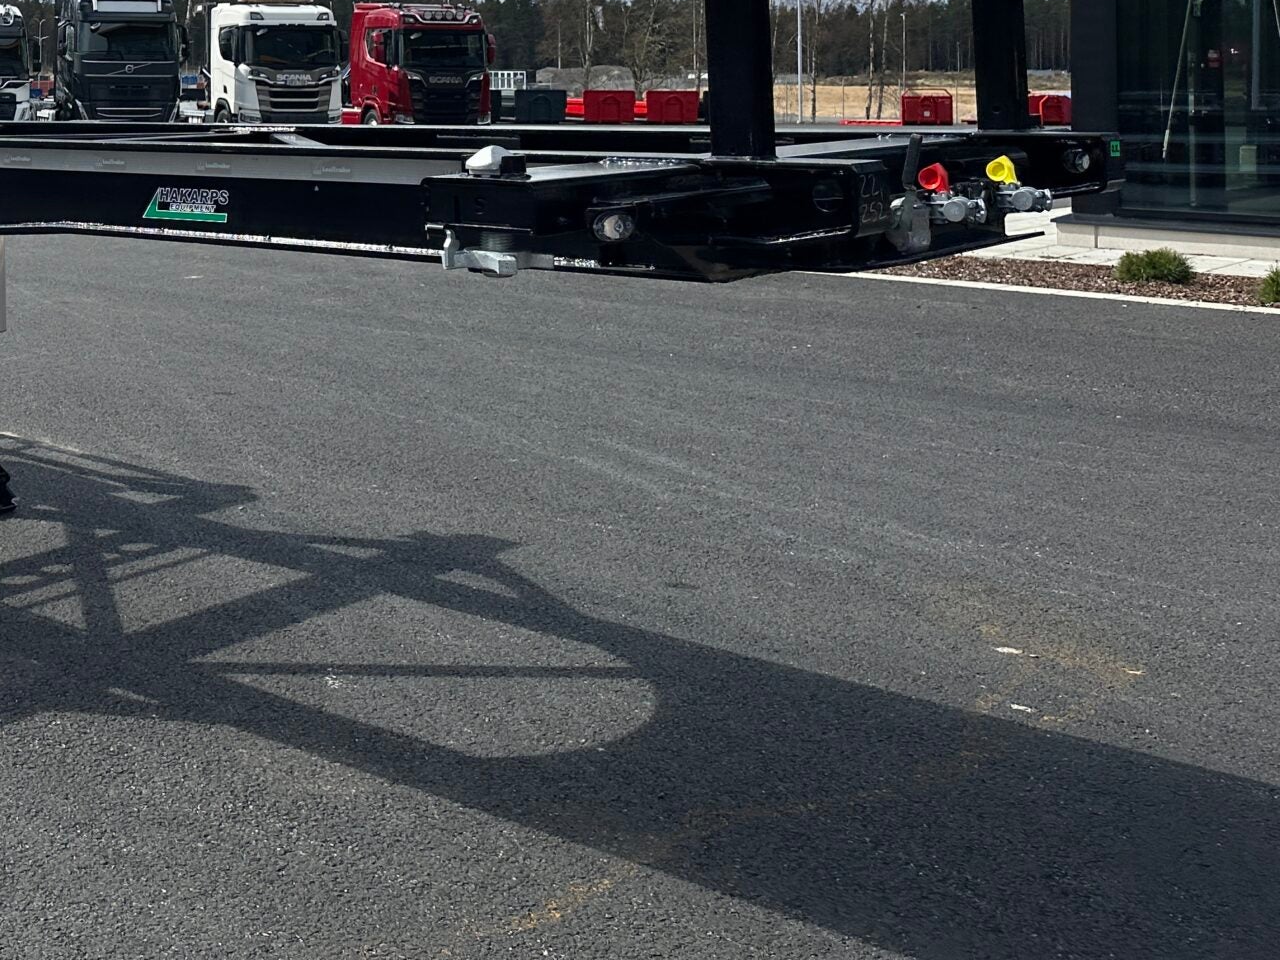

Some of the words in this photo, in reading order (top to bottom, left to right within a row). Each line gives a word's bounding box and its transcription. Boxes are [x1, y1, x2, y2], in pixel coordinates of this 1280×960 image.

[428, 76, 464, 84] SCANIA
[859, 174, 880, 198] 22
[158, 187, 229, 205] HAKARPS
[169, 203, 217, 212] EQUIPMENT
[859, 201, 887, 223] 252
